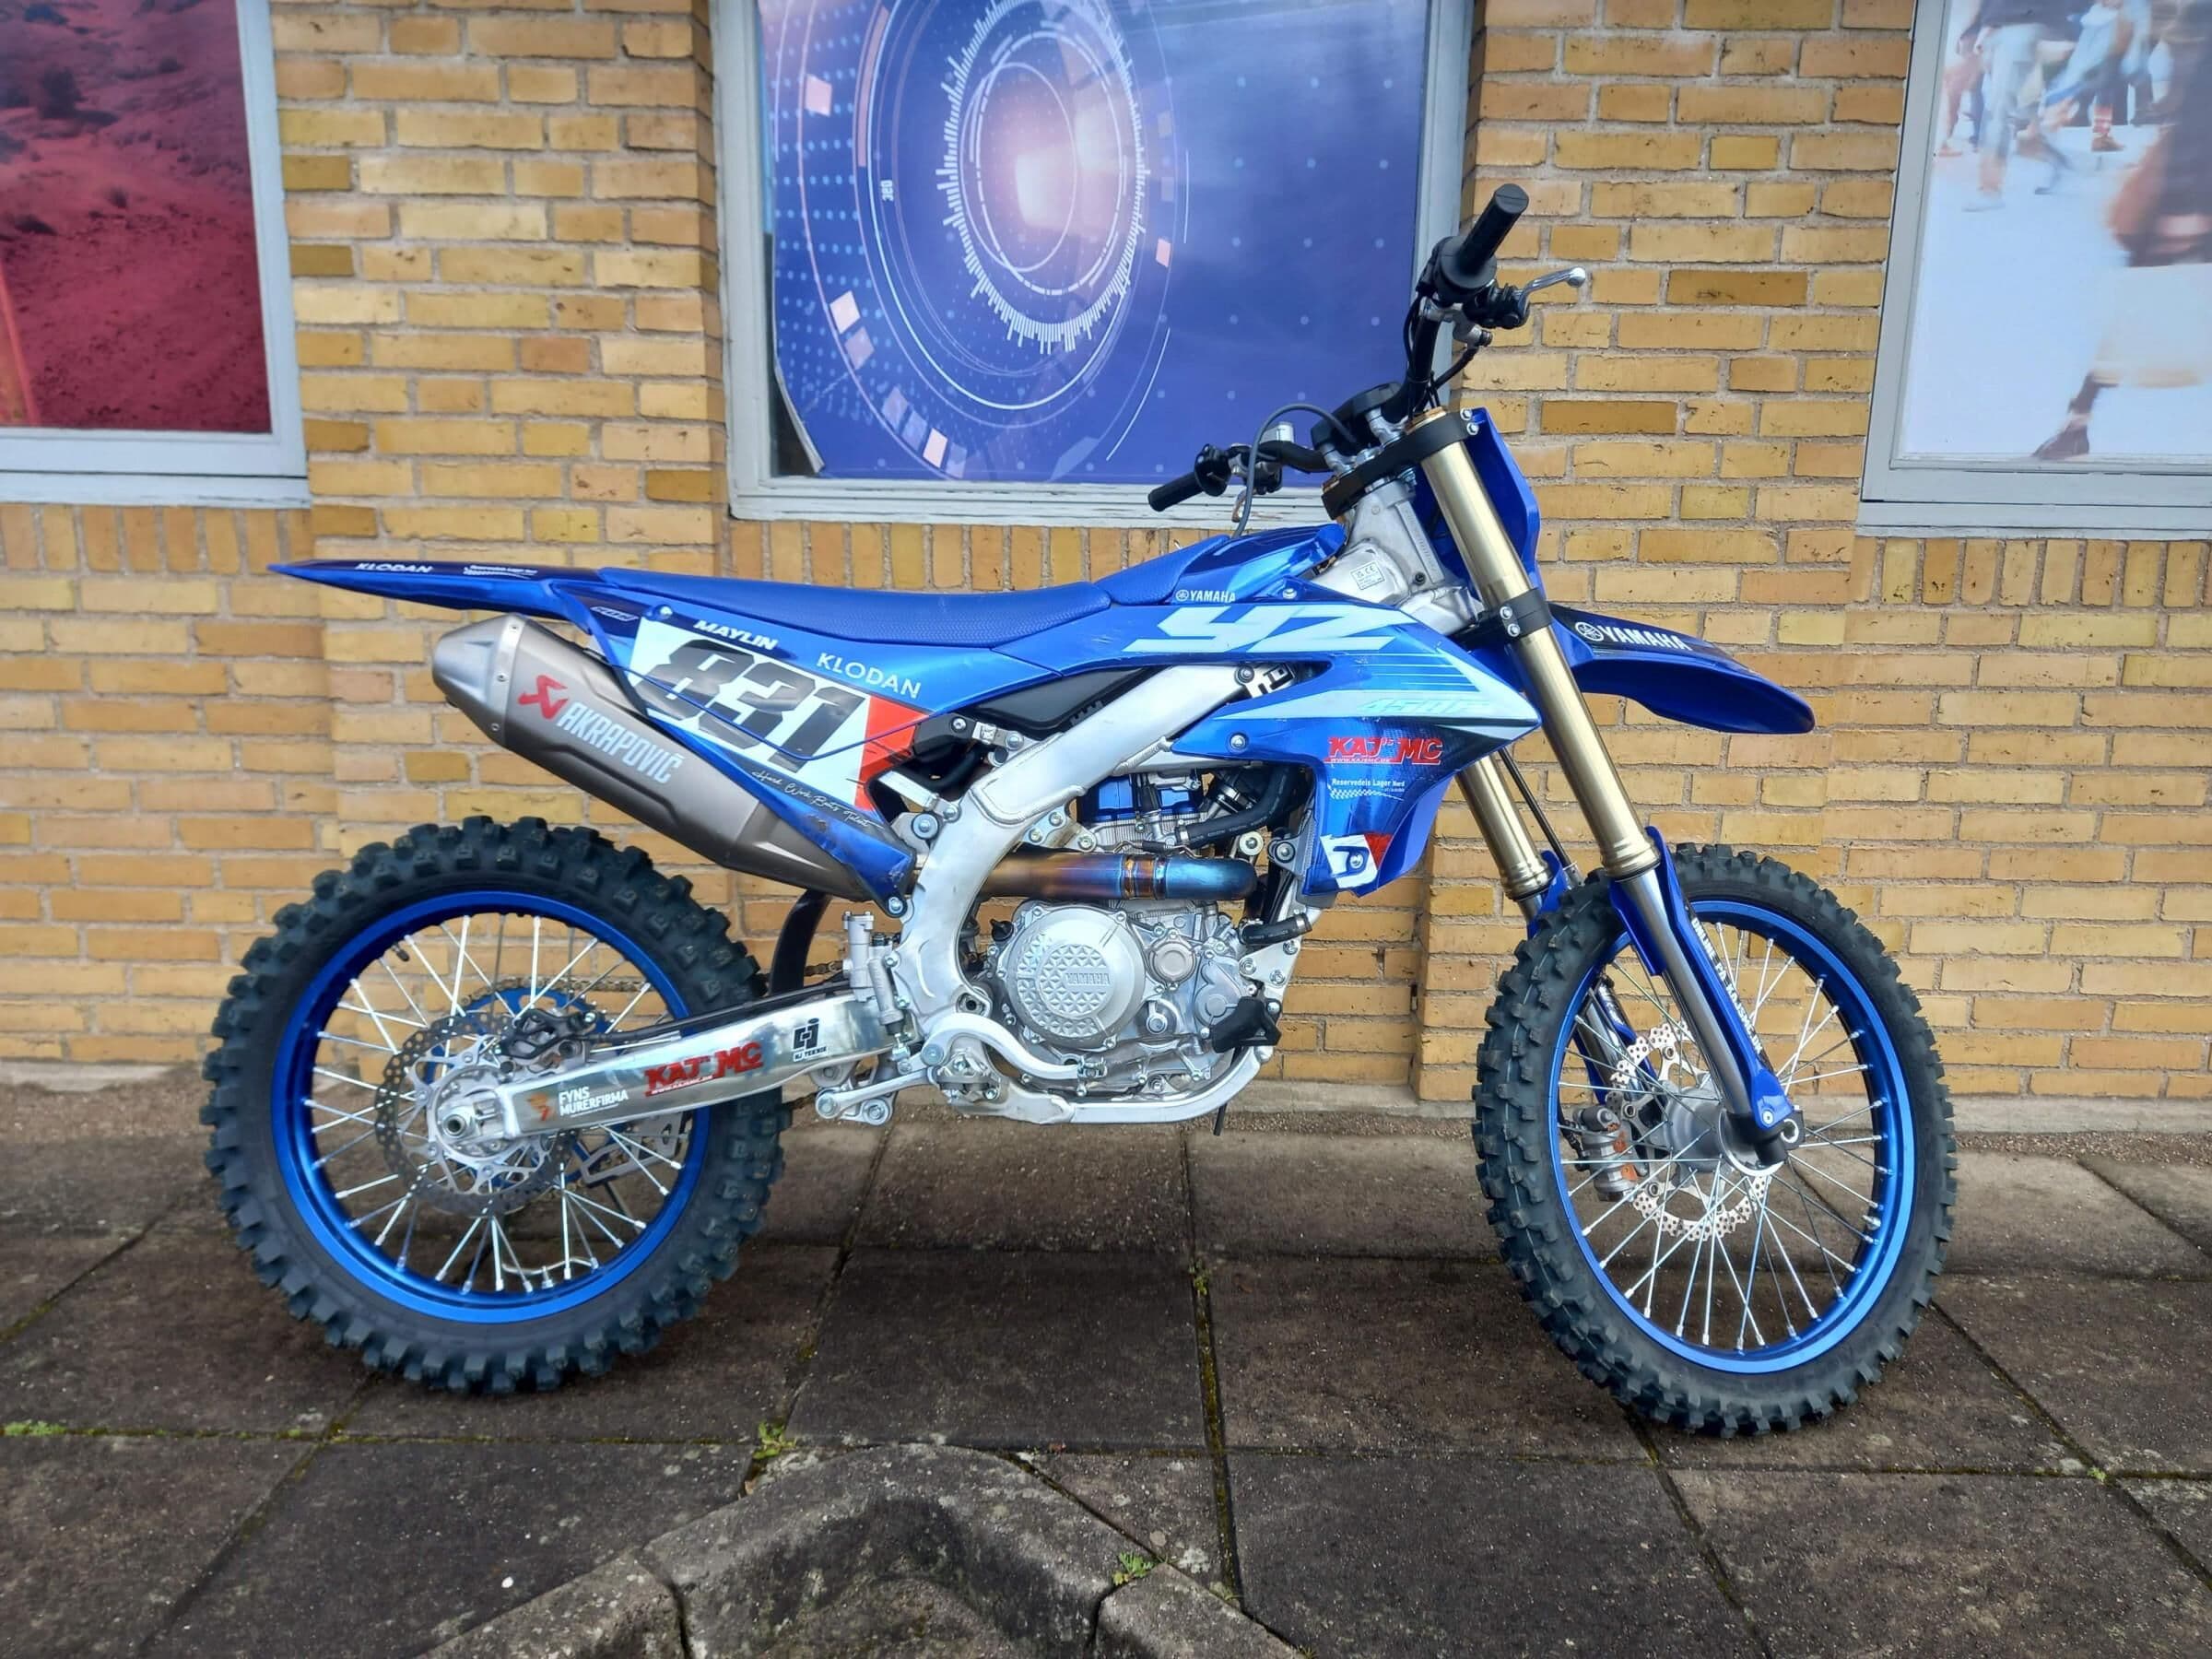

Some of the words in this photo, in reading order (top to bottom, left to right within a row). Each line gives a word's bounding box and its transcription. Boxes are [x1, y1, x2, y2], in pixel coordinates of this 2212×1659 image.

[354, 562, 434, 573] KLODAN
[1190, 589, 1236, 604] YAMAHA
[693, 619, 779, 651] MAYLIN
[1122, 605, 1418, 653] YZ
[1596, 625, 1693, 652] YAMAHA
[817, 653, 922, 700] KLODAN
[633, 639, 866, 774] 831
[1397, 737, 1444, 765] MC
[1690, 917, 1716, 960] ONLINE
[1065, 972, 1112, 985] YAMAHA
[713, 1041, 764, 1078] MC
[559, 1086, 590, 1105] FYNS
[559, 1088, 629, 1116] MURERFIRMA
